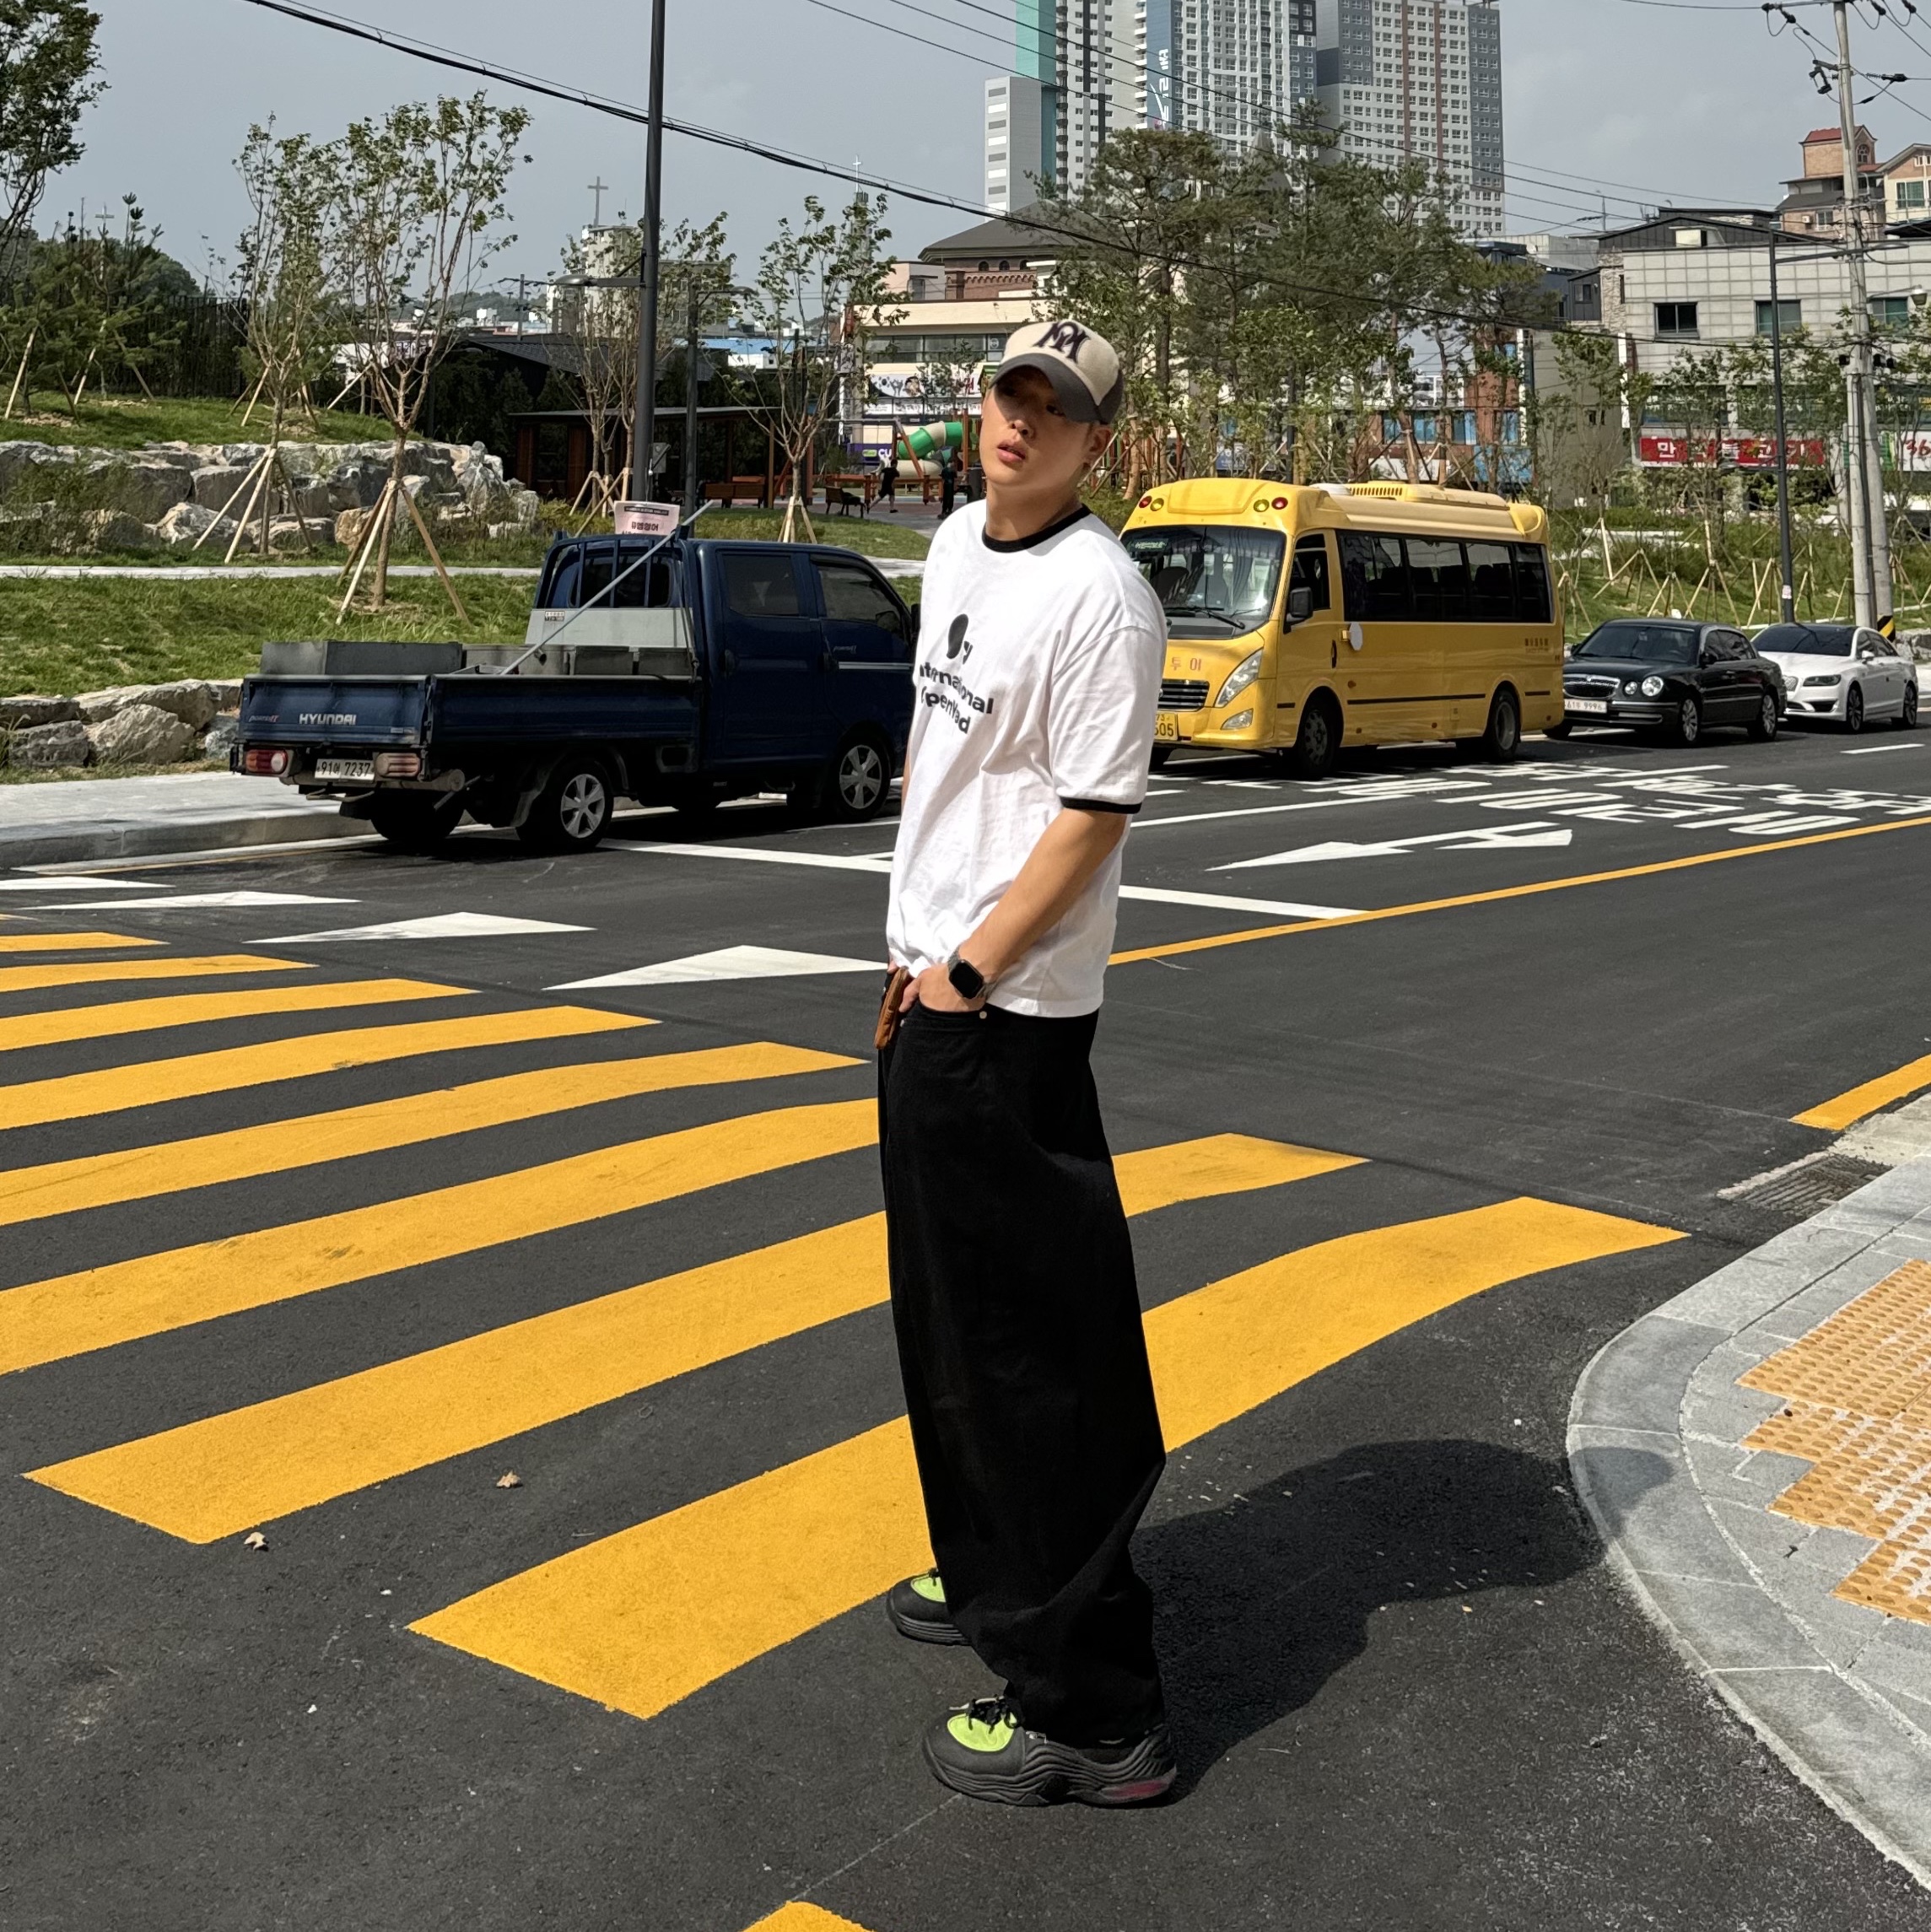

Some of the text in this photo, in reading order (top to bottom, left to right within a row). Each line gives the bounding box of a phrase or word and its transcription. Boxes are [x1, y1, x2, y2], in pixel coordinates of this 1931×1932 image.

[877, 448, 892, 458] CU
[299, 713, 357, 726] HYUNDAI
[344, 762, 370, 777] 7237
[1434, 788, 1860, 834] 어린이
